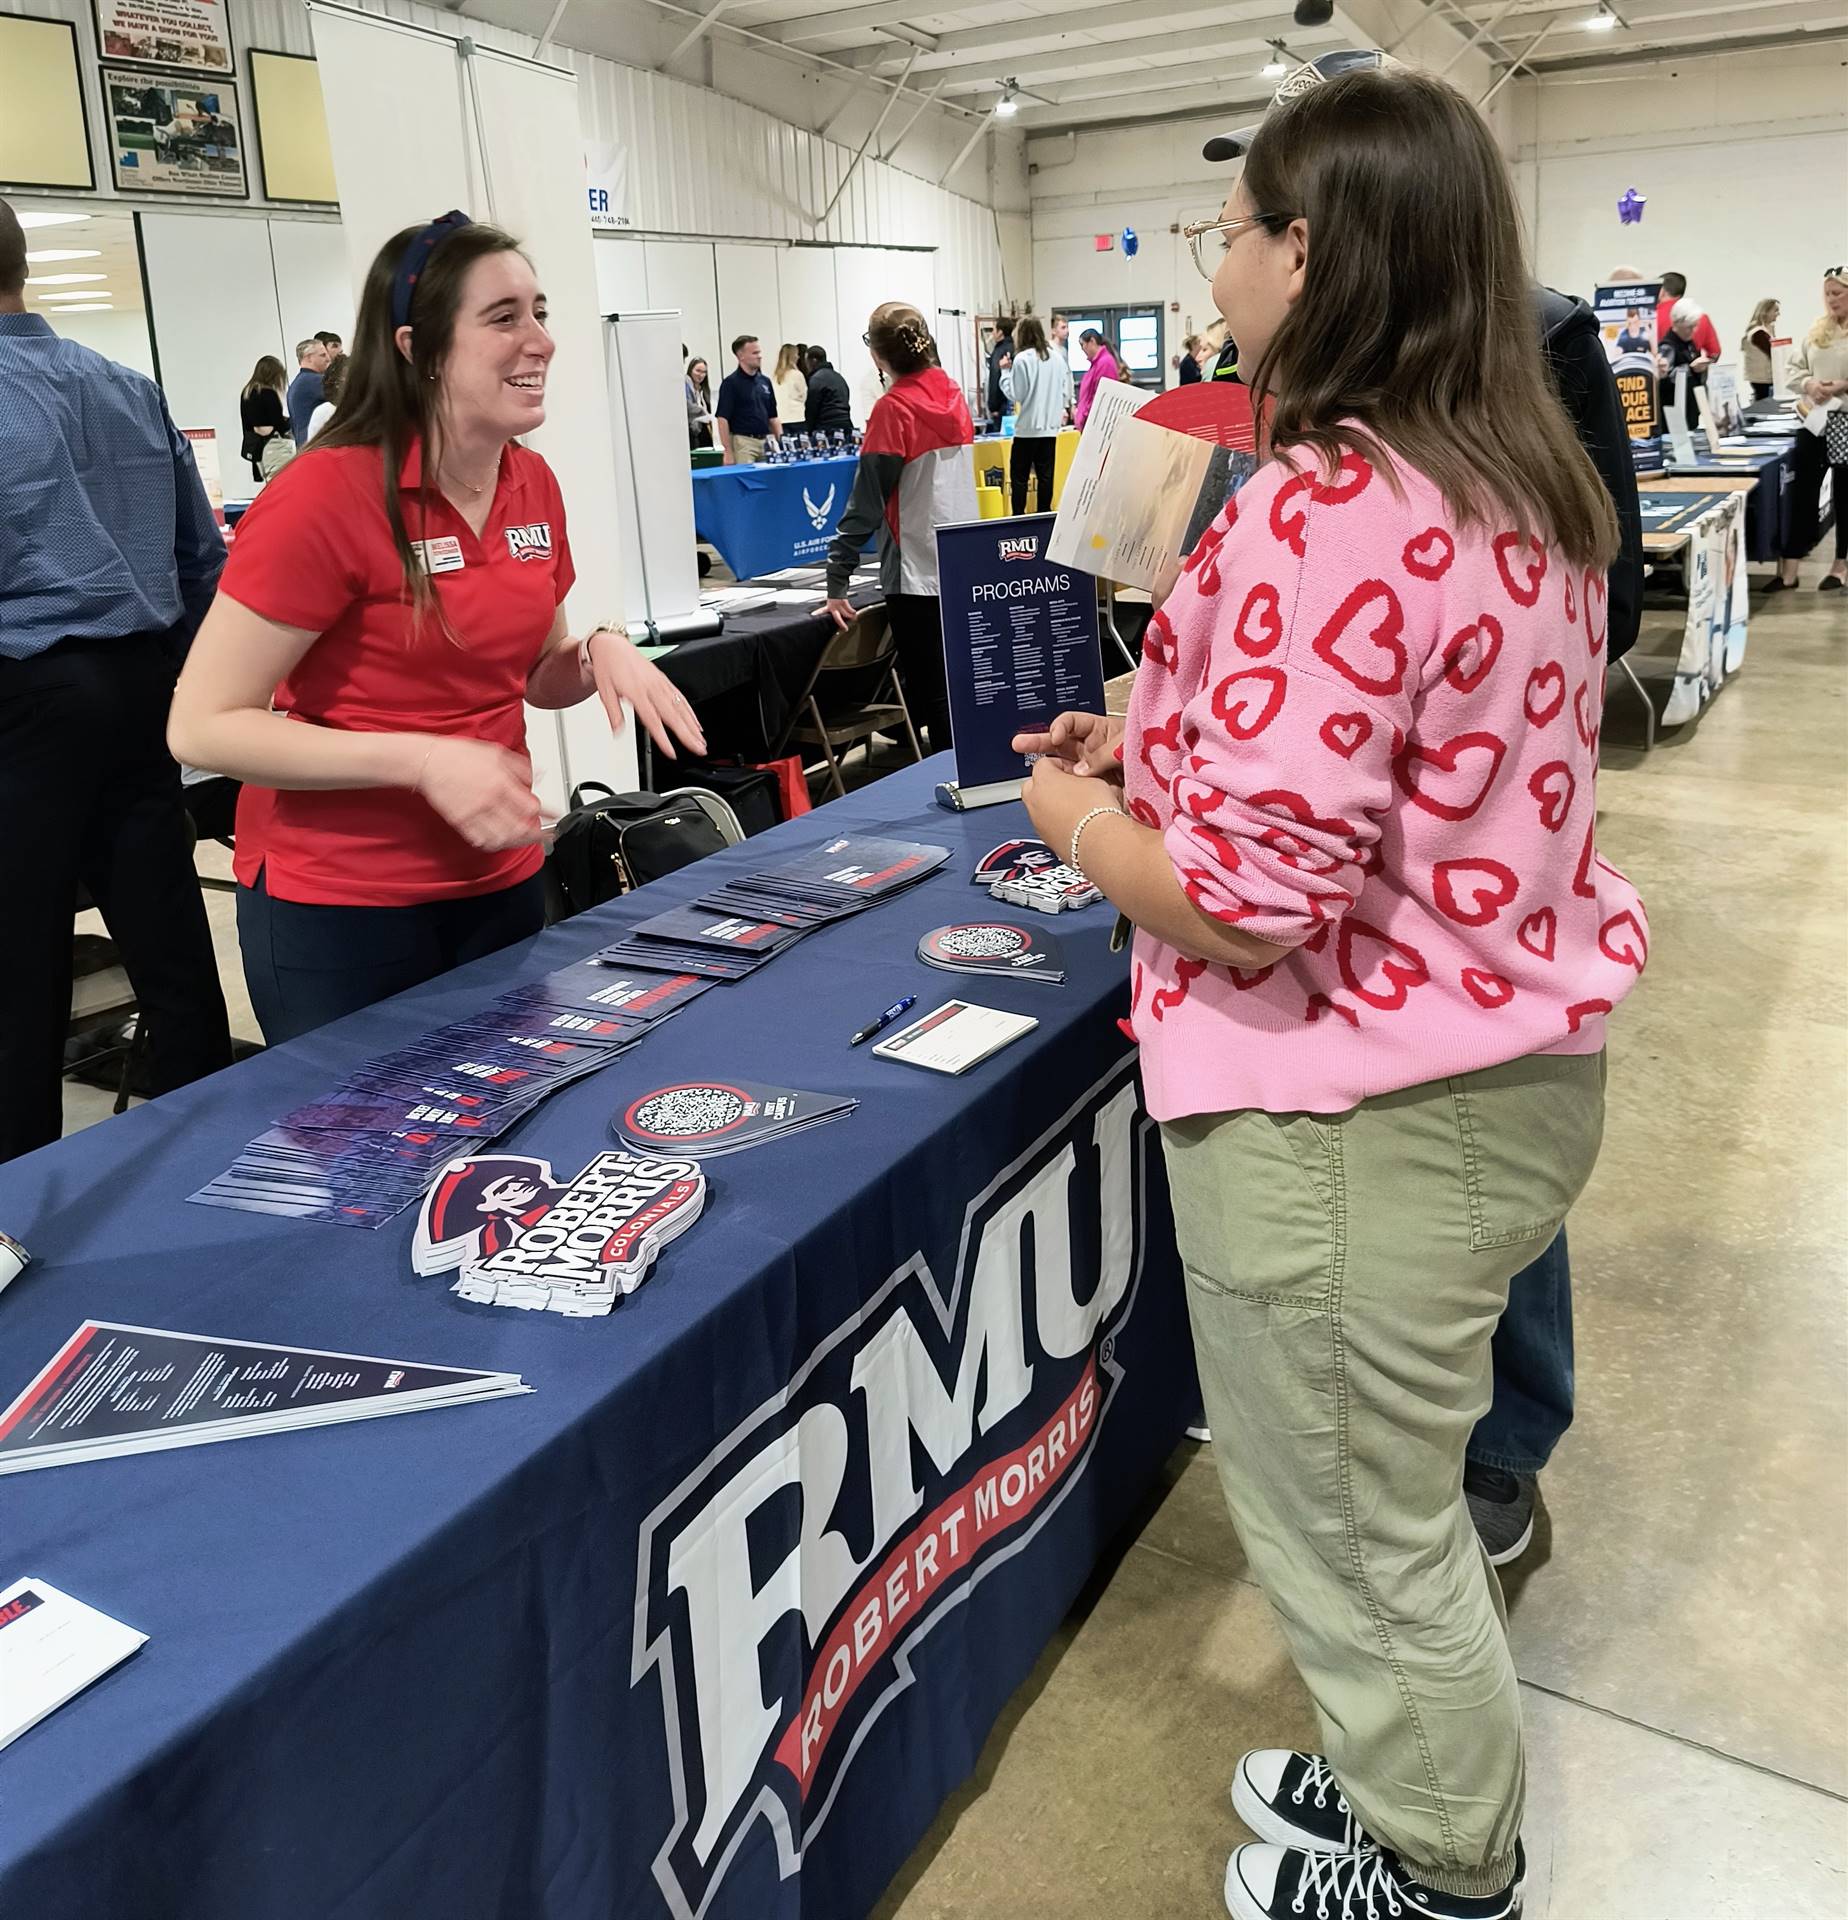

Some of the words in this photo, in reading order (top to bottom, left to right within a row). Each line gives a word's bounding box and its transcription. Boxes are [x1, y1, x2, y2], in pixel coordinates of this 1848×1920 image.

[115, 10, 160, 23] WHATEVER
[588, 188, 608, 212] ER
[1616, 376, 1646, 391] FIND
[1621, 391, 1649, 407] OUR
[1626, 405, 1651, 422] ACE
[505, 523, 552, 556] RMU
[999, 538, 1037, 557] RMU
[972, 574, 1071, 602] PROGRAMS
[1000, 863, 1075, 891] ROB
[483, 1153, 638, 1274] ROBERT
[532, 1160, 694, 1282] MORRIS
[610, 1185, 690, 1257] COLONIALS
[668, 1081, 1139, 1867] RMU
[801, 1505, 967, 1782] ROBERT
[973, 1376, 1095, 1529] MORRIS
